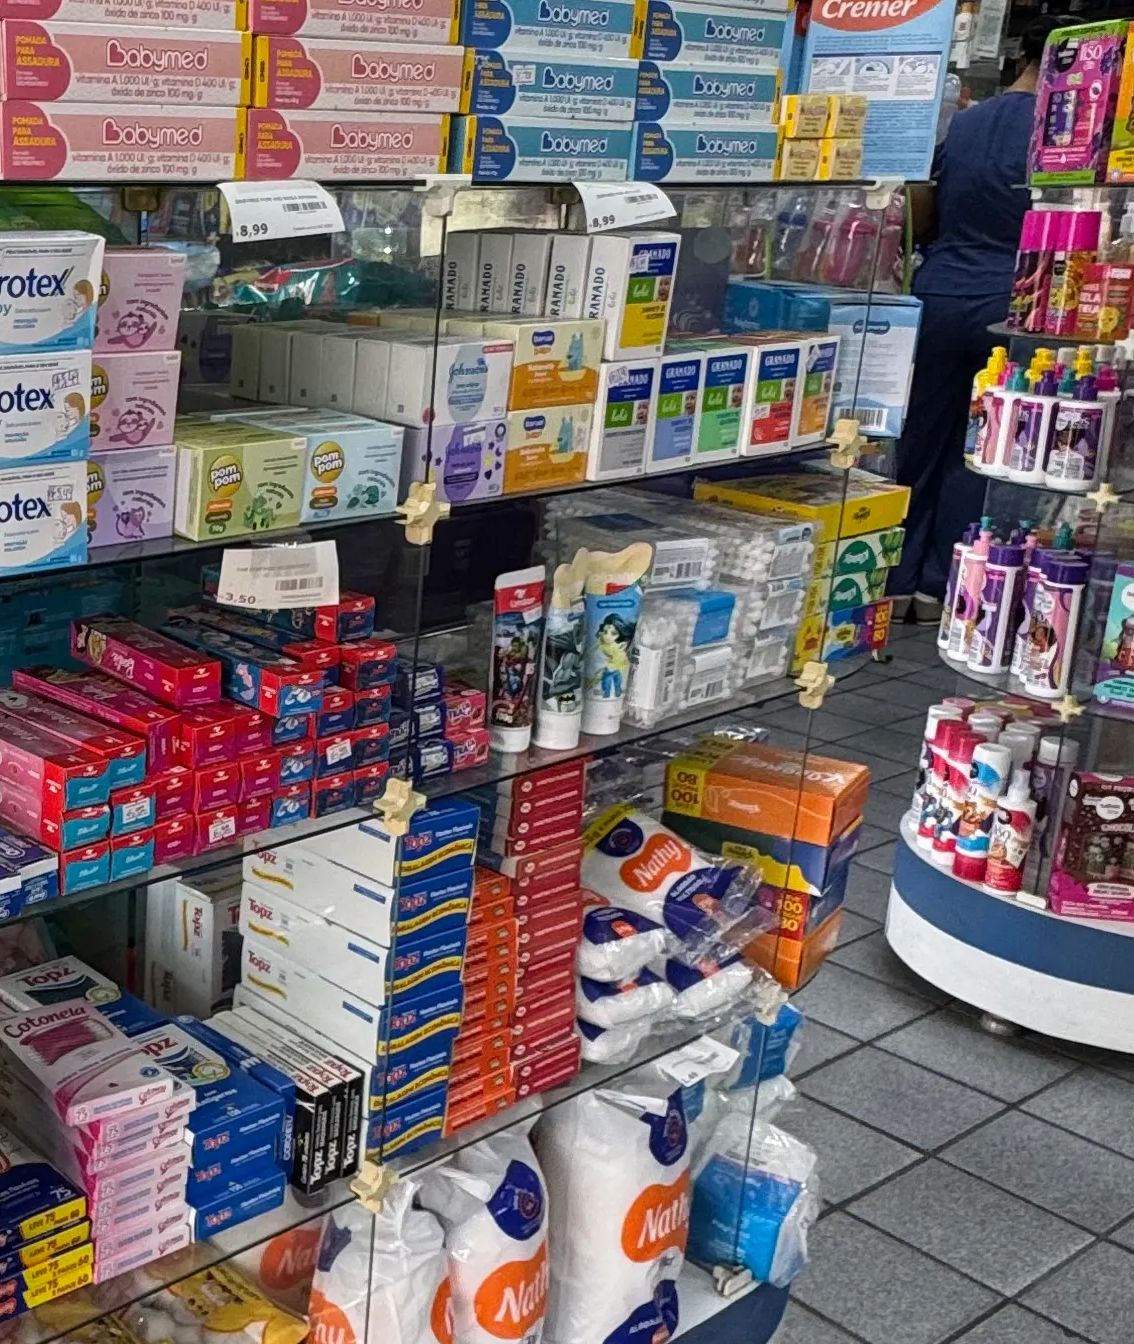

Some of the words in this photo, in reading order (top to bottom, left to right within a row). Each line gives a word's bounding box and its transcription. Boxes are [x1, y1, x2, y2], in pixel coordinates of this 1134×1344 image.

[538, 0, 610, 26] Babymed
[106, 40, 208, 72] Babymed
[102, 118, 203, 148] Babymed
[240, 223, 268, 237] 8,99
[589, 267, 606, 318] RANADO
[314, 453, 338, 466] pom
[318, 458, 343, 472] pom
[210, 465, 237, 479] pom
[214, 473, 241, 489] pom
[632, 839, 682, 887] Nathy
[249, 898, 273, 921] Topz
[248, 950, 272, 973] Topz
[23, 966, 77, 987] Topz
[3, 1006, 86, 1039] Cotonela
[47, 1279, 58, 1291] 75
[77, 1273, 89, 1284] 60
